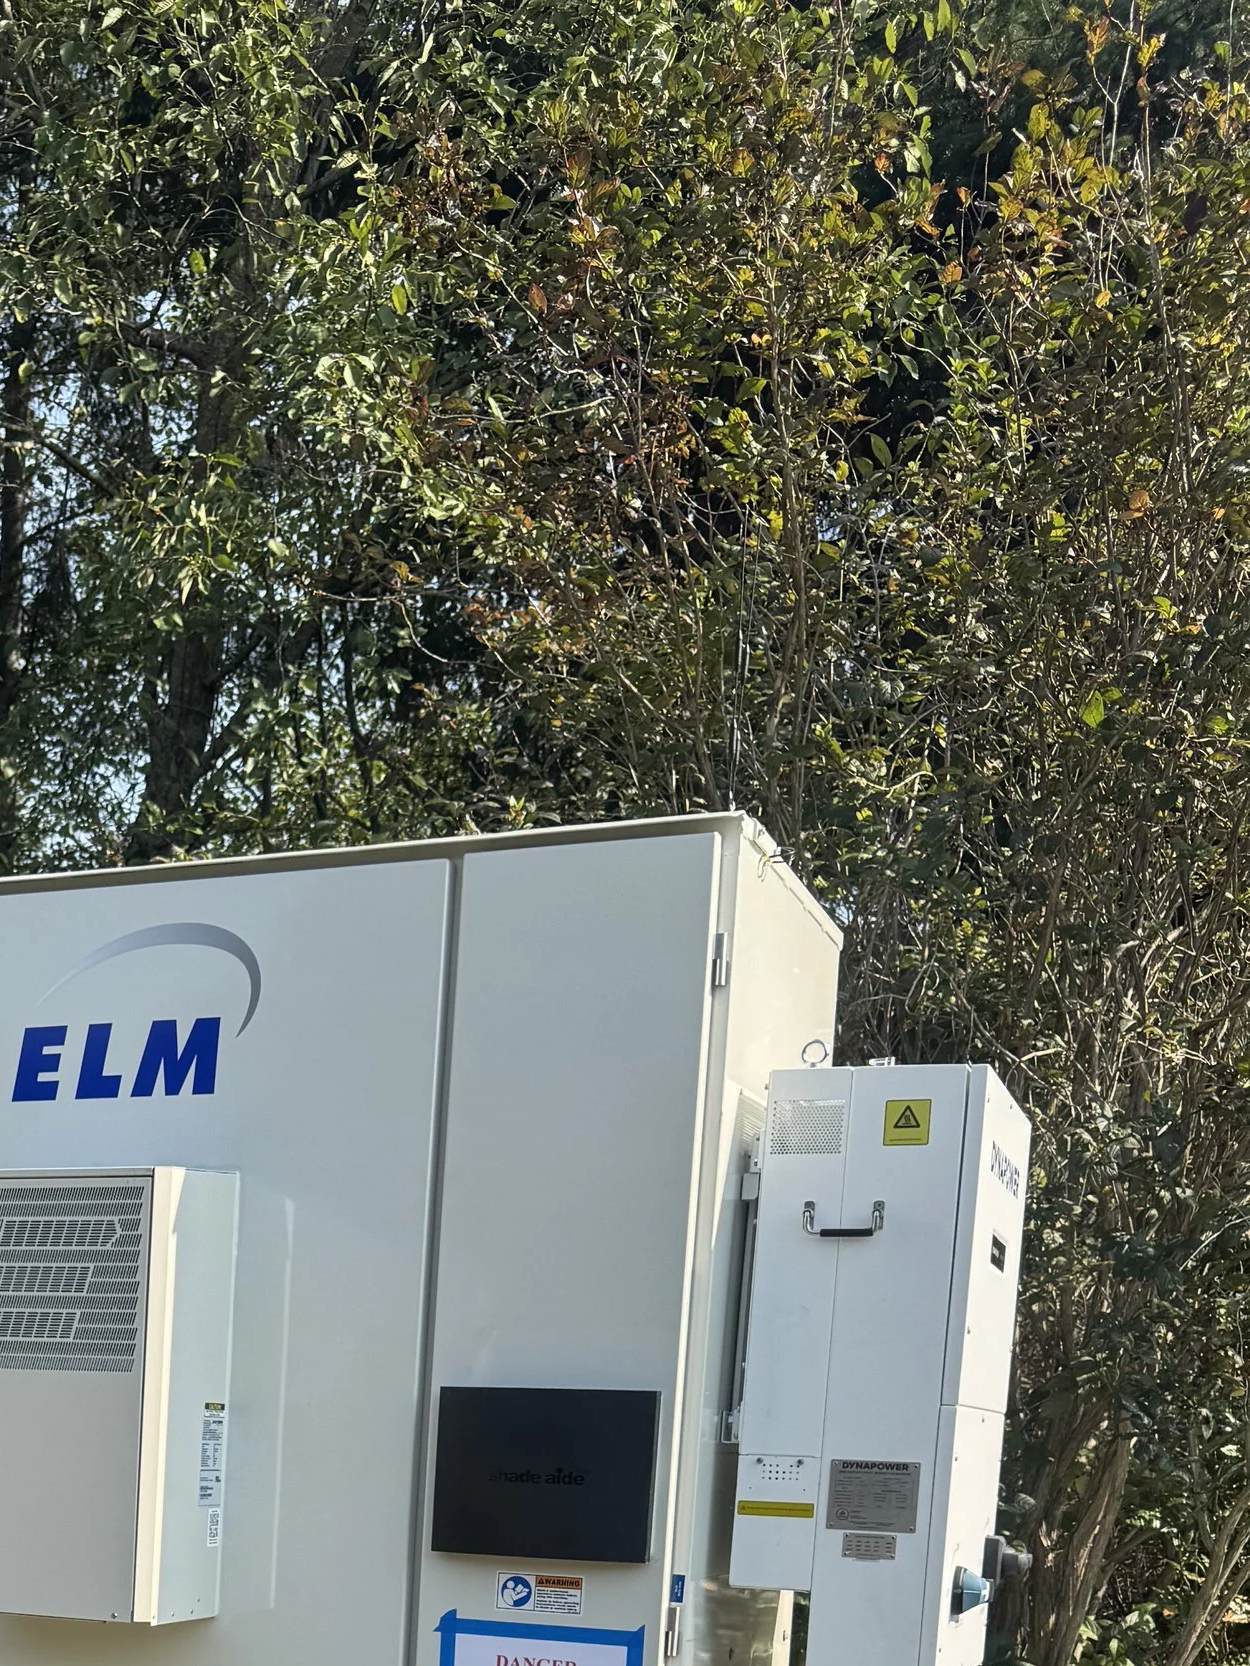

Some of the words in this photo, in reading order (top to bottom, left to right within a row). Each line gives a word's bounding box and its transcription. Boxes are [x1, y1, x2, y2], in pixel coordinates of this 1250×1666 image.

[11, 1017, 221, 1102] ELM
[990, 1140, 1020, 1200] DYNAPOWER
[842, 1462, 909, 1471] DYNAPOWER
[545, 1467, 586, 1485] aide
[545, 1579, 580, 1587] WARNING
